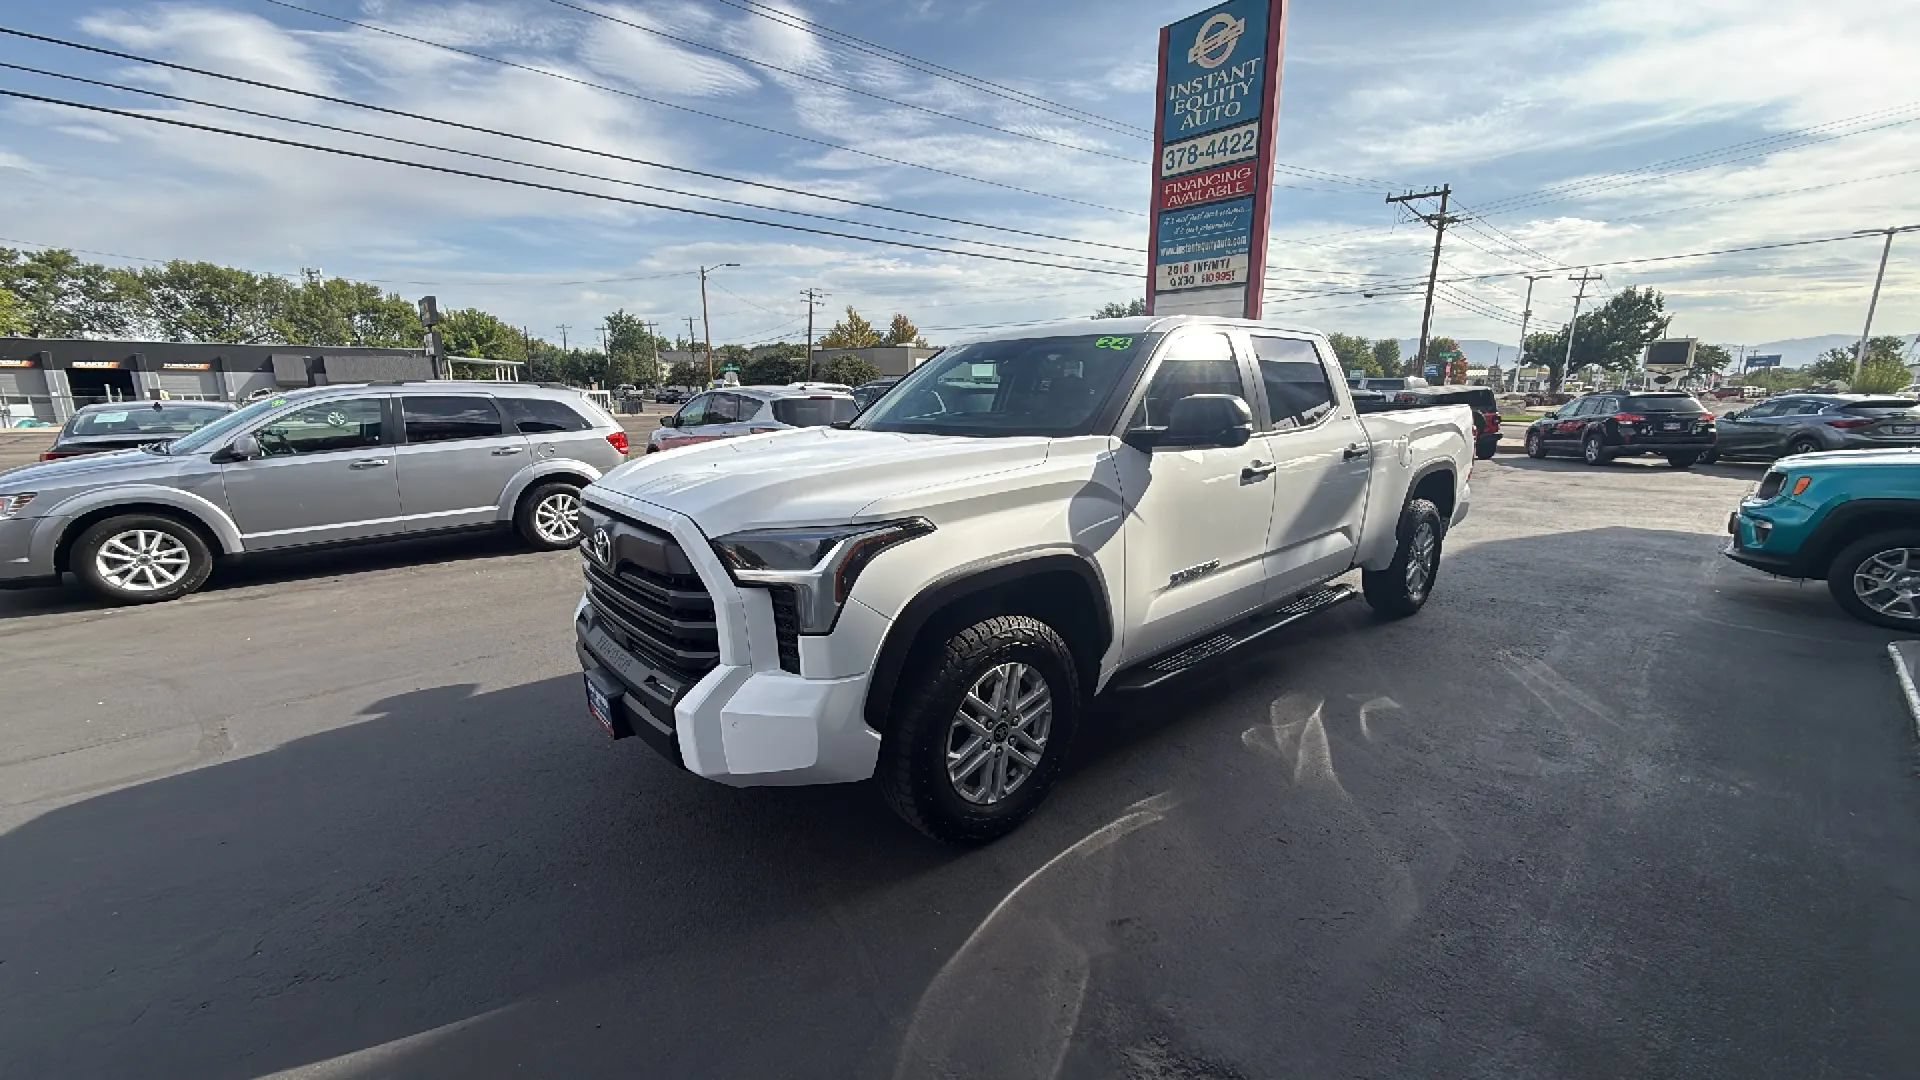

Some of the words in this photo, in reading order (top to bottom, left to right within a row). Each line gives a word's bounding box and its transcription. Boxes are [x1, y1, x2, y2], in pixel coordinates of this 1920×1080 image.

[1170, 58, 1260, 100] INSTANT
[1174, 78, 1254, 116] EQUITY
[1180, 102, 1241, 130] AUTO
[1166, 130, 1254, 170] 378-4422
[1165, 168, 1252, 195] FINANCING
[1168, 181, 1247, 207] AVAILABLE
[1161, 236, 1247, 256] www.instantequityauto.com
